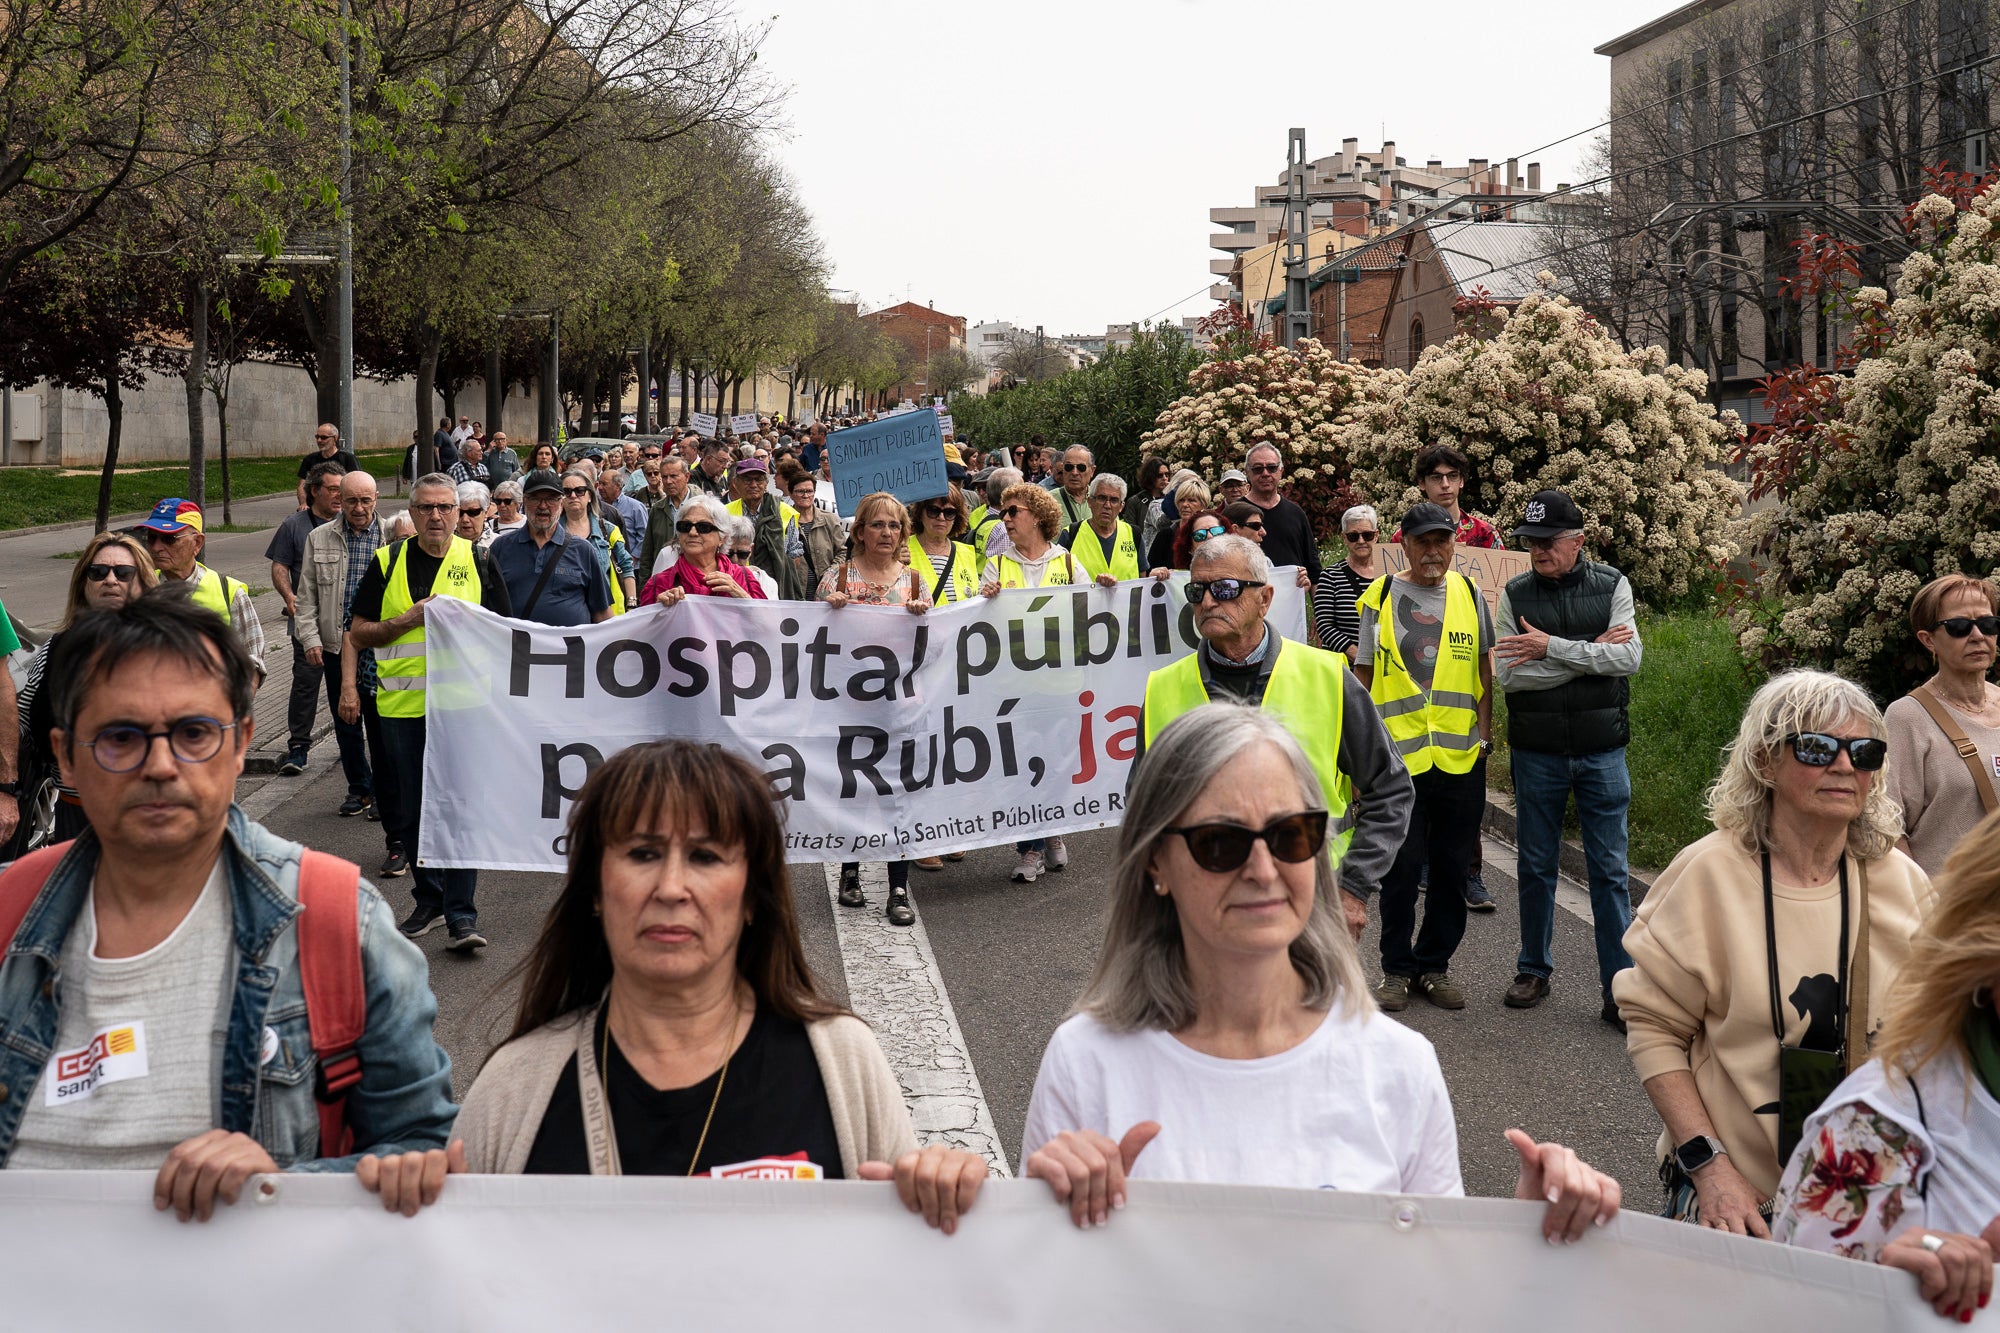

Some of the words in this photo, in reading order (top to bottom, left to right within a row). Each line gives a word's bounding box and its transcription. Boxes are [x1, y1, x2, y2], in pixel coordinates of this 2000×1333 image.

[834, 436, 880, 465] SANITAT
[885, 425, 937, 452] PUBLICA
[873, 458, 940, 492] QUALITAT
[1448, 631, 1474, 646] MPD
[509, 617, 929, 716] Hospital
[761, 742, 806, 801] a
[837, 697, 1046, 801] Rubí,
[785, 832, 844, 850] titats
[851, 833, 888, 853] per
[894, 826, 910, 845] la
[915, 814, 985, 843] Sanitat
[992, 803, 1065, 830] Pública
[1073, 796, 1101, 816] de
[57, 1063, 105, 1098] sant
[585, 1087, 608, 1168] KIPLING
